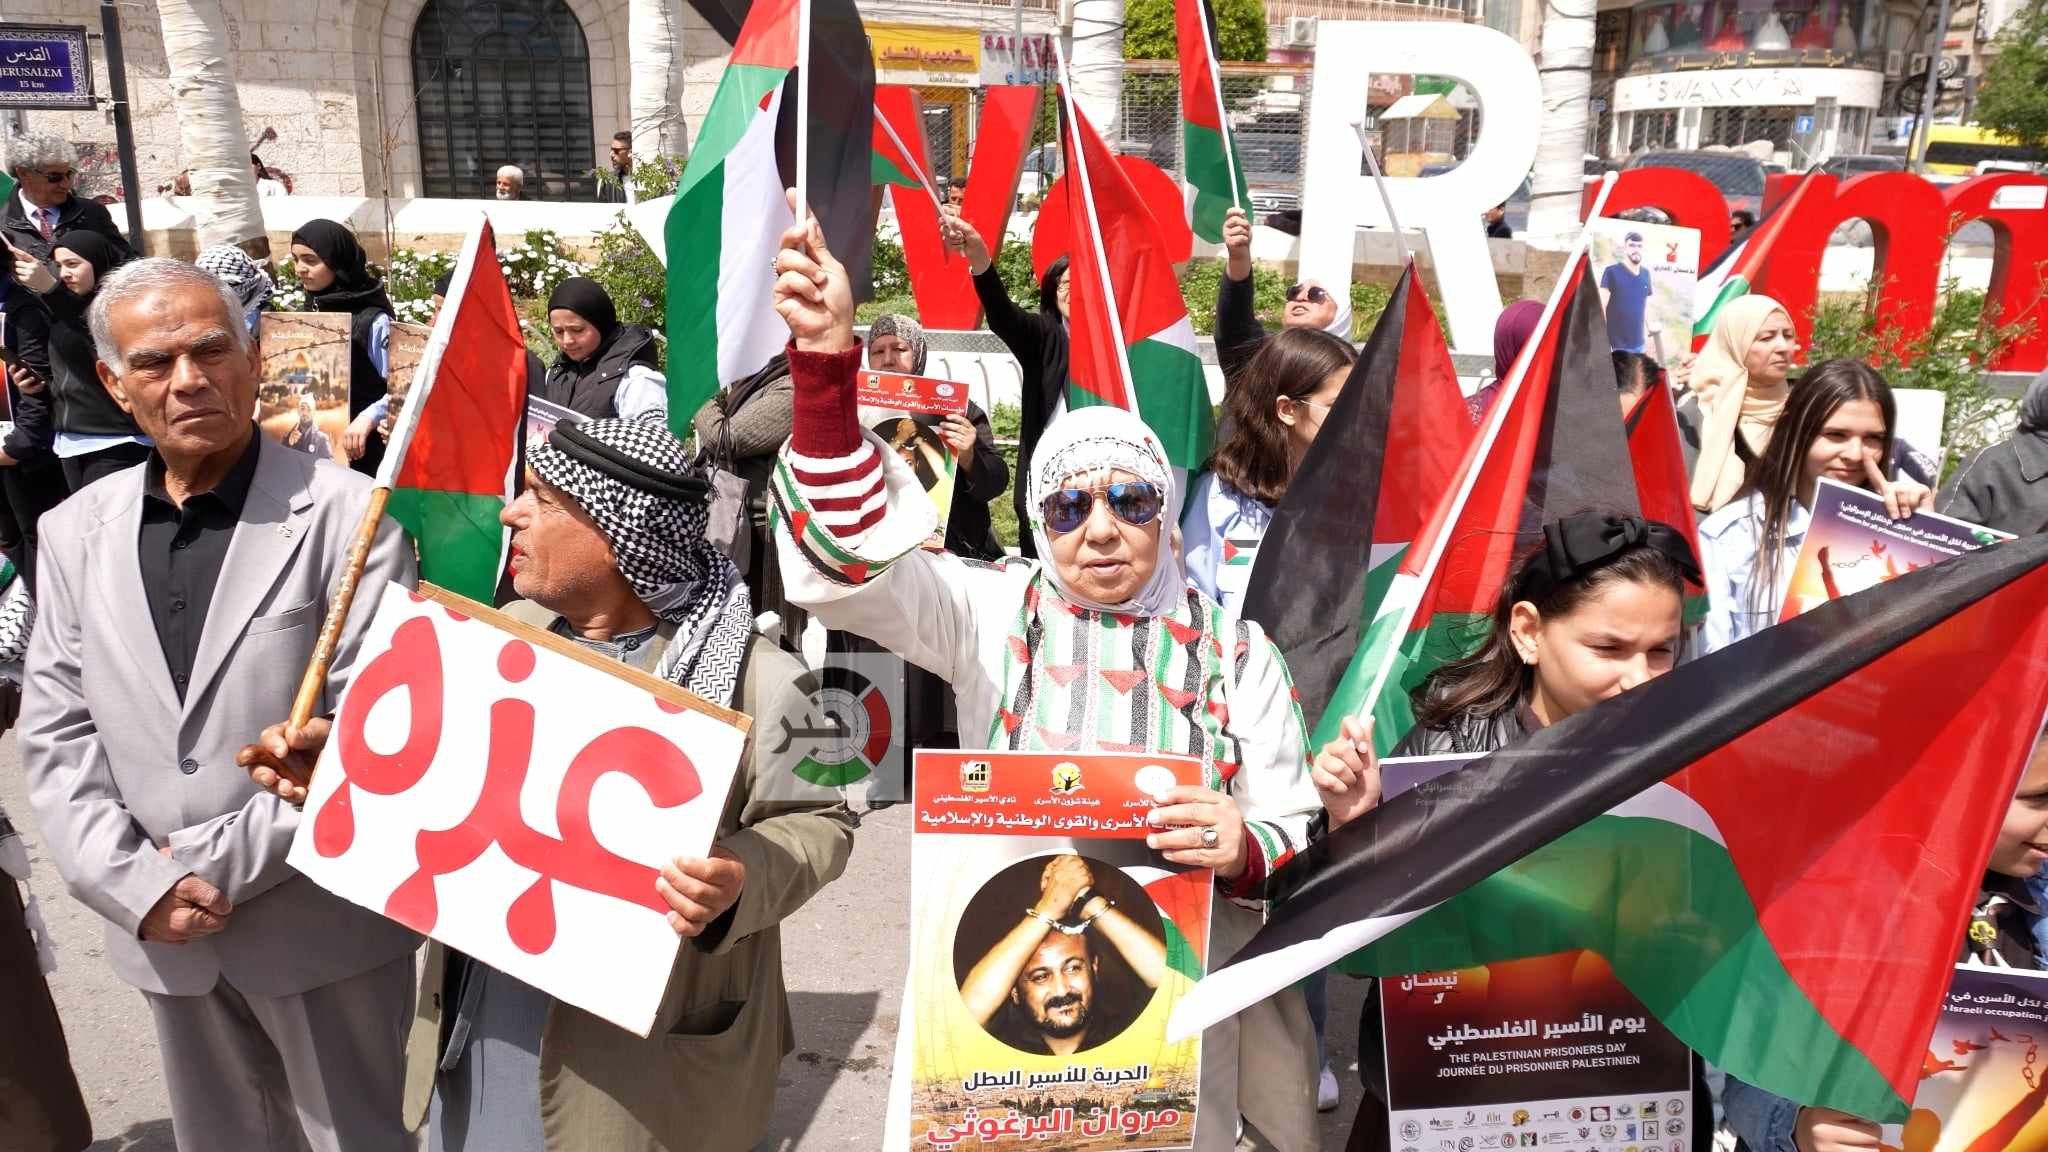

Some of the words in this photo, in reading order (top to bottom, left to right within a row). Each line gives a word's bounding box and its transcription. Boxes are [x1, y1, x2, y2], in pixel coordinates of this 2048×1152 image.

[6, 46, 51, 63] القدس
[20, 80, 29, 88] 15
[31, 80, 45, 88] km
[920, 810, 993, 828] والإسلامية
[995, 812, 1051, 828] الوطنية
[1054, 814, 1098, 831] والقوى
[1101, 813, 1149, 831] الأسرى
[1951, 992, 1971, 1003] في
[1973, 993, 2016, 1004] الأسرى
[2017, 998, 2041, 1007] لكل
[1949, 1004, 1983, 1014] Israeli
[1984, 1008, 2042, 1020] occupation
[1543, 1012, 1603, 1039] الأسير
[1608, 1014, 1647, 1035] يوم
[1428, 1019, 1537, 1051] الفلسطيني
[1449, 1054, 1471, 1064] THE
[1473, 1049, 1542, 1063] PALESTINIAN
[1544, 1045, 1604, 1058] PRISONERS
[1606, 1043, 1627, 1053] DAY
[1093, 1065, 1149, 1086] الحرية
[1437, 1063, 1486, 1078] JOURNÉE
[1488, 1065, 1504, 1075] DU
[1506, 1060, 1570, 1074] PRISONNIER
[1572, 1055, 1640, 1069] PALESTINIEN
[964, 1070, 1020, 1091] البطل
[1028, 1067, 1086, 1090] للأسير
[927, 1105, 1073, 1151] البرغوثي
[1082, 1106, 1181, 1136] مروان
